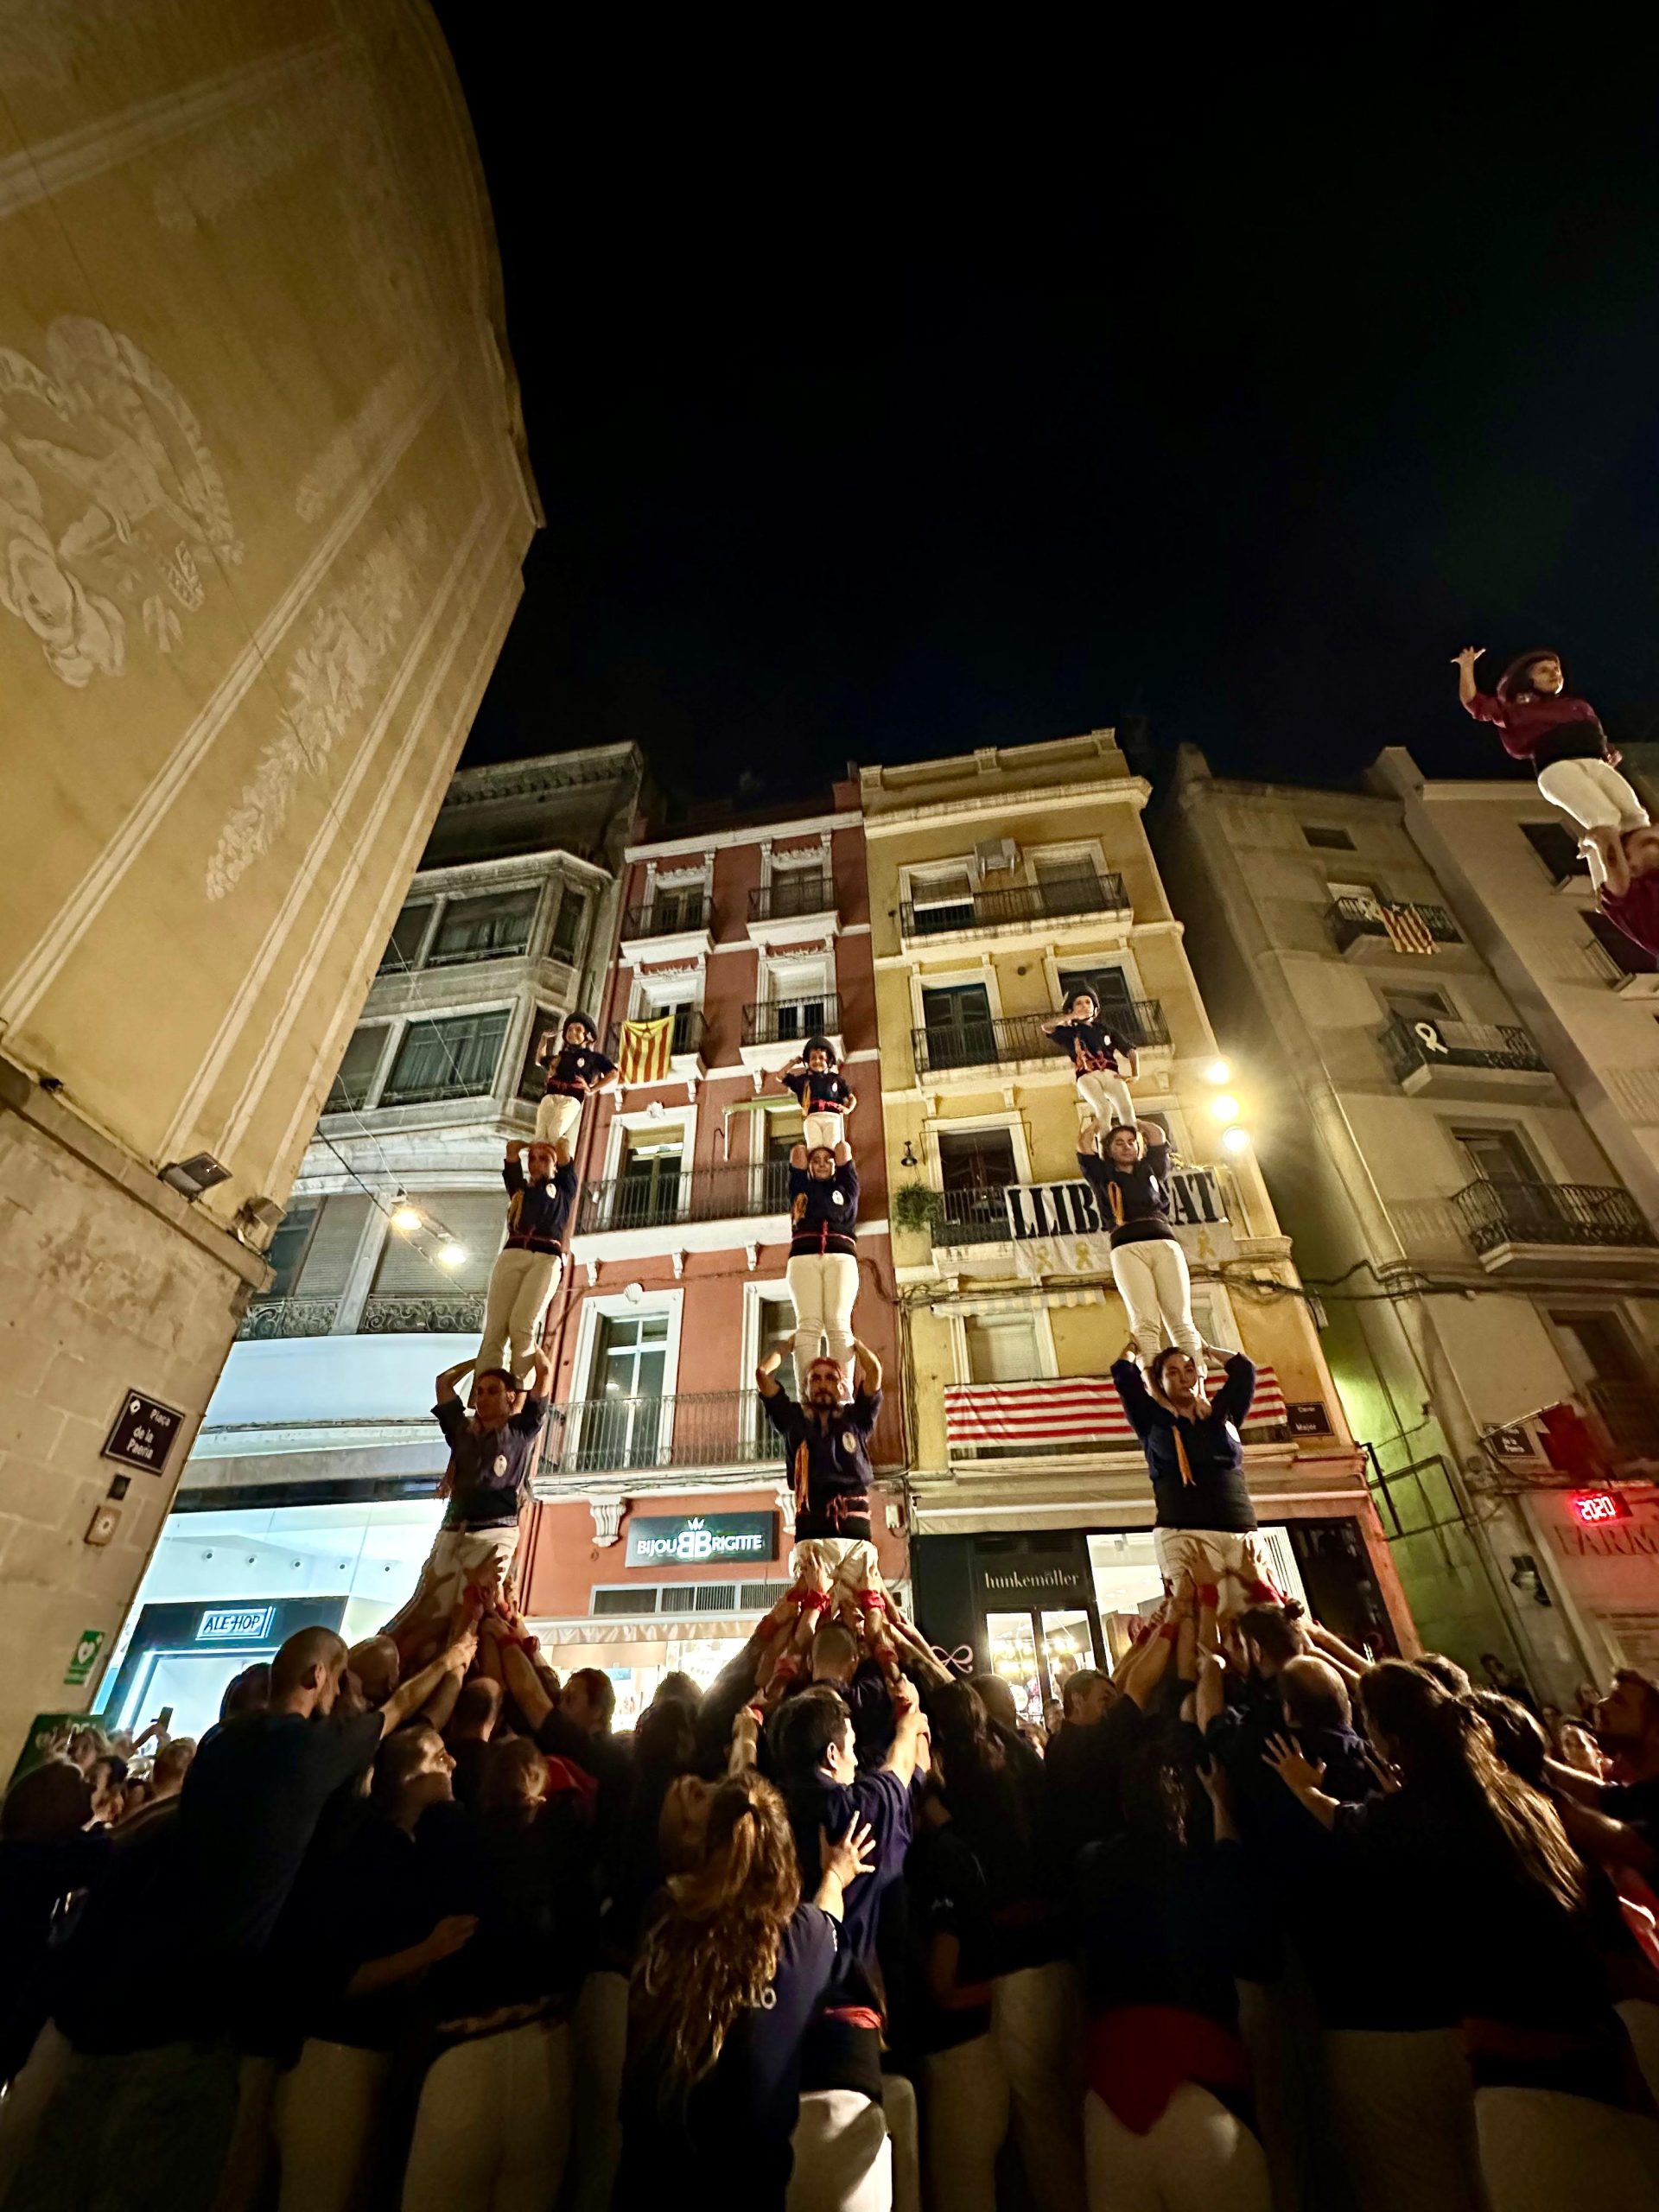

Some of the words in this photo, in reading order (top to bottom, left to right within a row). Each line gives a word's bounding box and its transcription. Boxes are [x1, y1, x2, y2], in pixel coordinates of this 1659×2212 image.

[1007, 1171, 1218, 1239] LLIBAT
[133, 1425, 145, 1440] de
[985, 1568, 1079, 1589] hunkemöller
[203, 1615, 261, 1630] ALE-HOP
